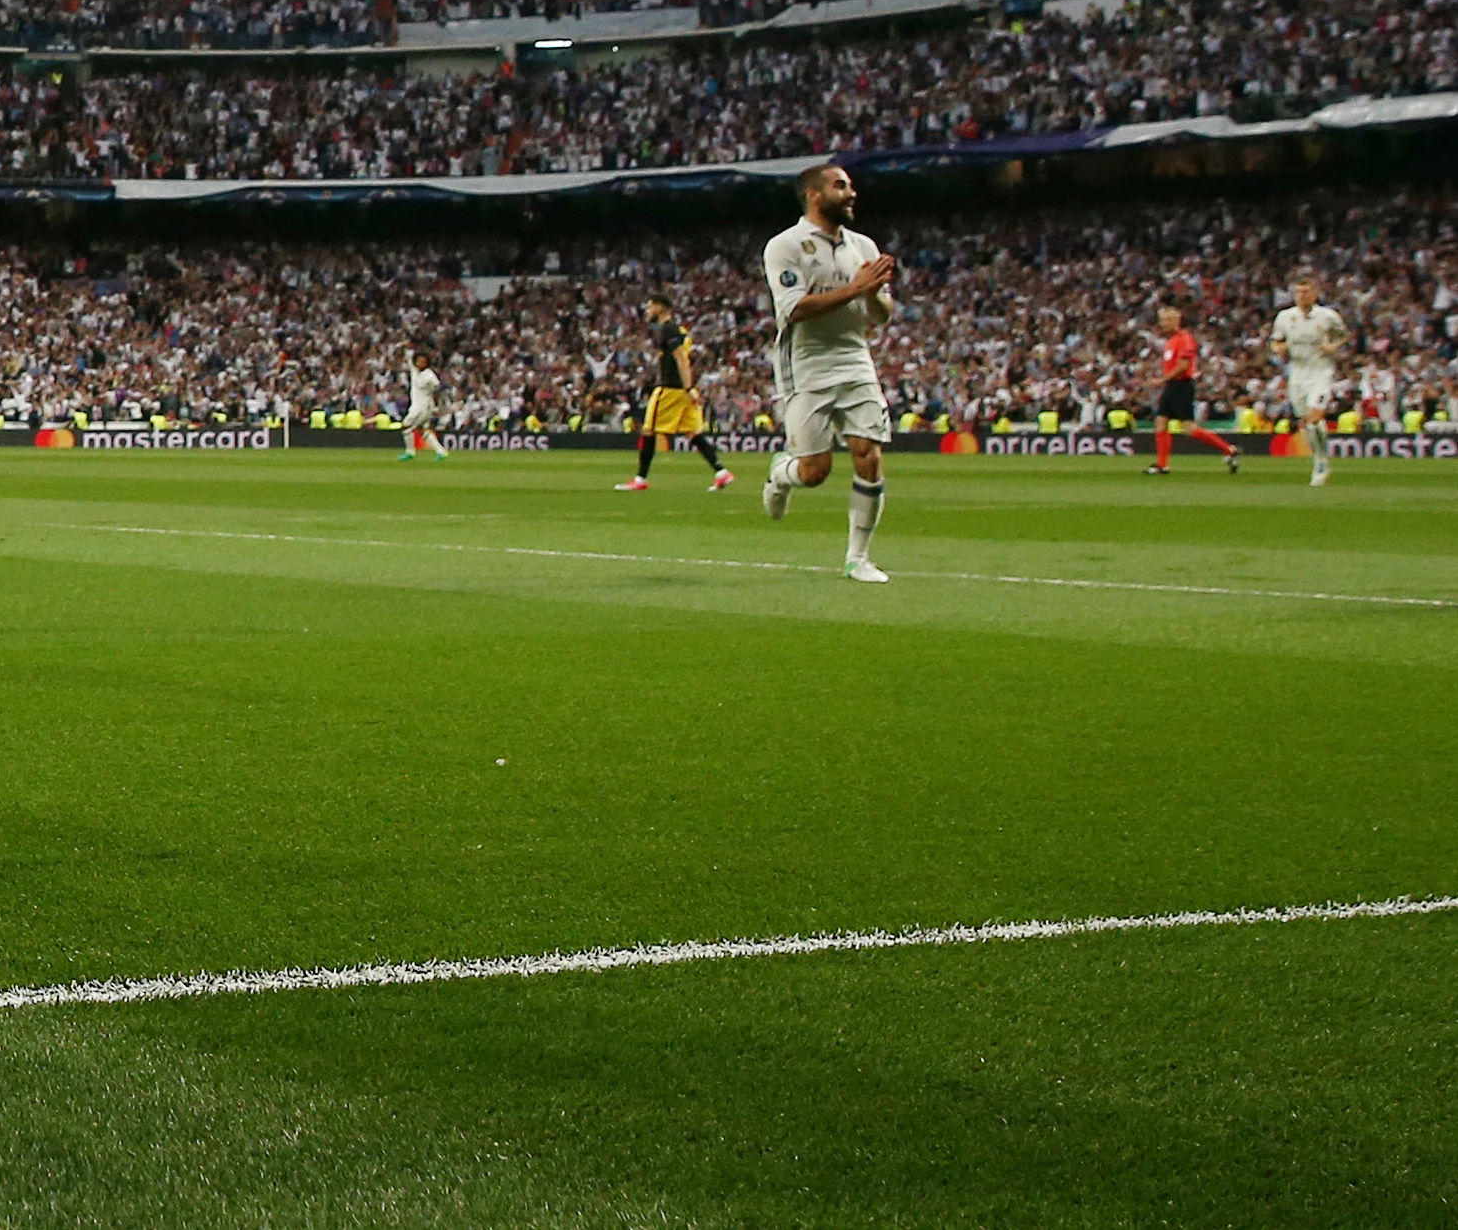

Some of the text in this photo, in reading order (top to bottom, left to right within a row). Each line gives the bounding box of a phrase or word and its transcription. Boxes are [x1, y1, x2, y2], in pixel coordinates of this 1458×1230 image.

[82, 427, 270, 449] mastercard
[443, 432, 550, 451] priceless
[673, 434, 785, 453] msterc
[985, 433, 1134, 456] priceless
